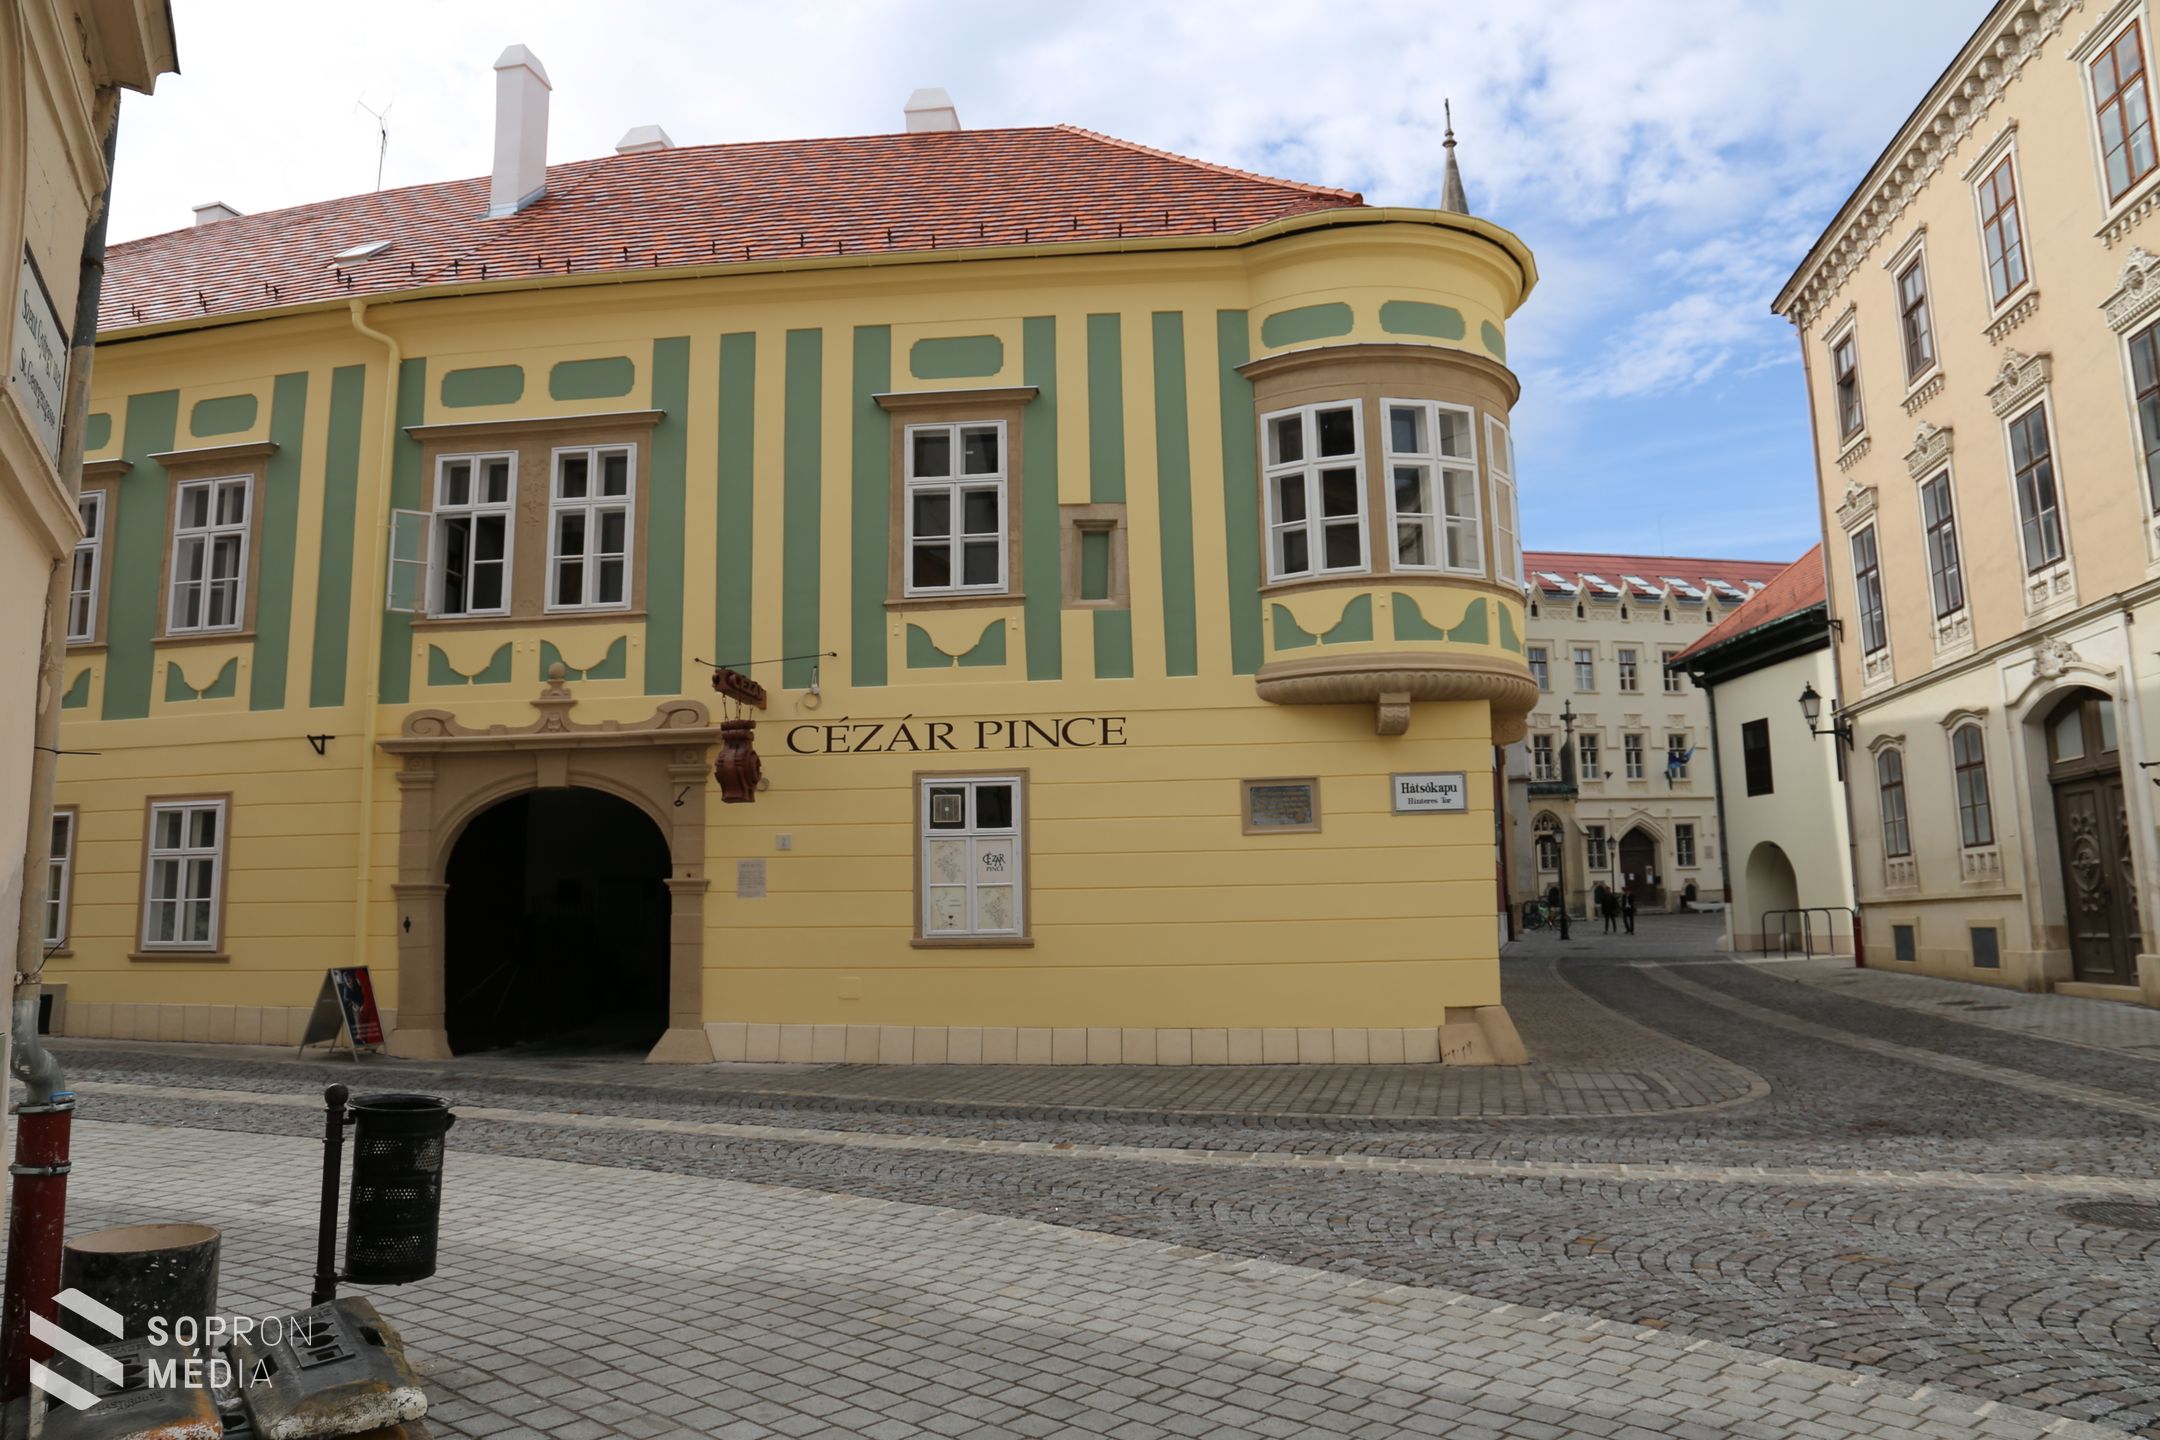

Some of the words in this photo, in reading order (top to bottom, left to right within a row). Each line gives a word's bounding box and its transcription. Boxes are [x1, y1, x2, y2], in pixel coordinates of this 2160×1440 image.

[22, 289, 37, 341] Szent
[786, 713, 959, 754] CÉZÁR
[974, 717, 1128, 749] PINCE
[1401, 782, 1458, 796] Hátsókapu
